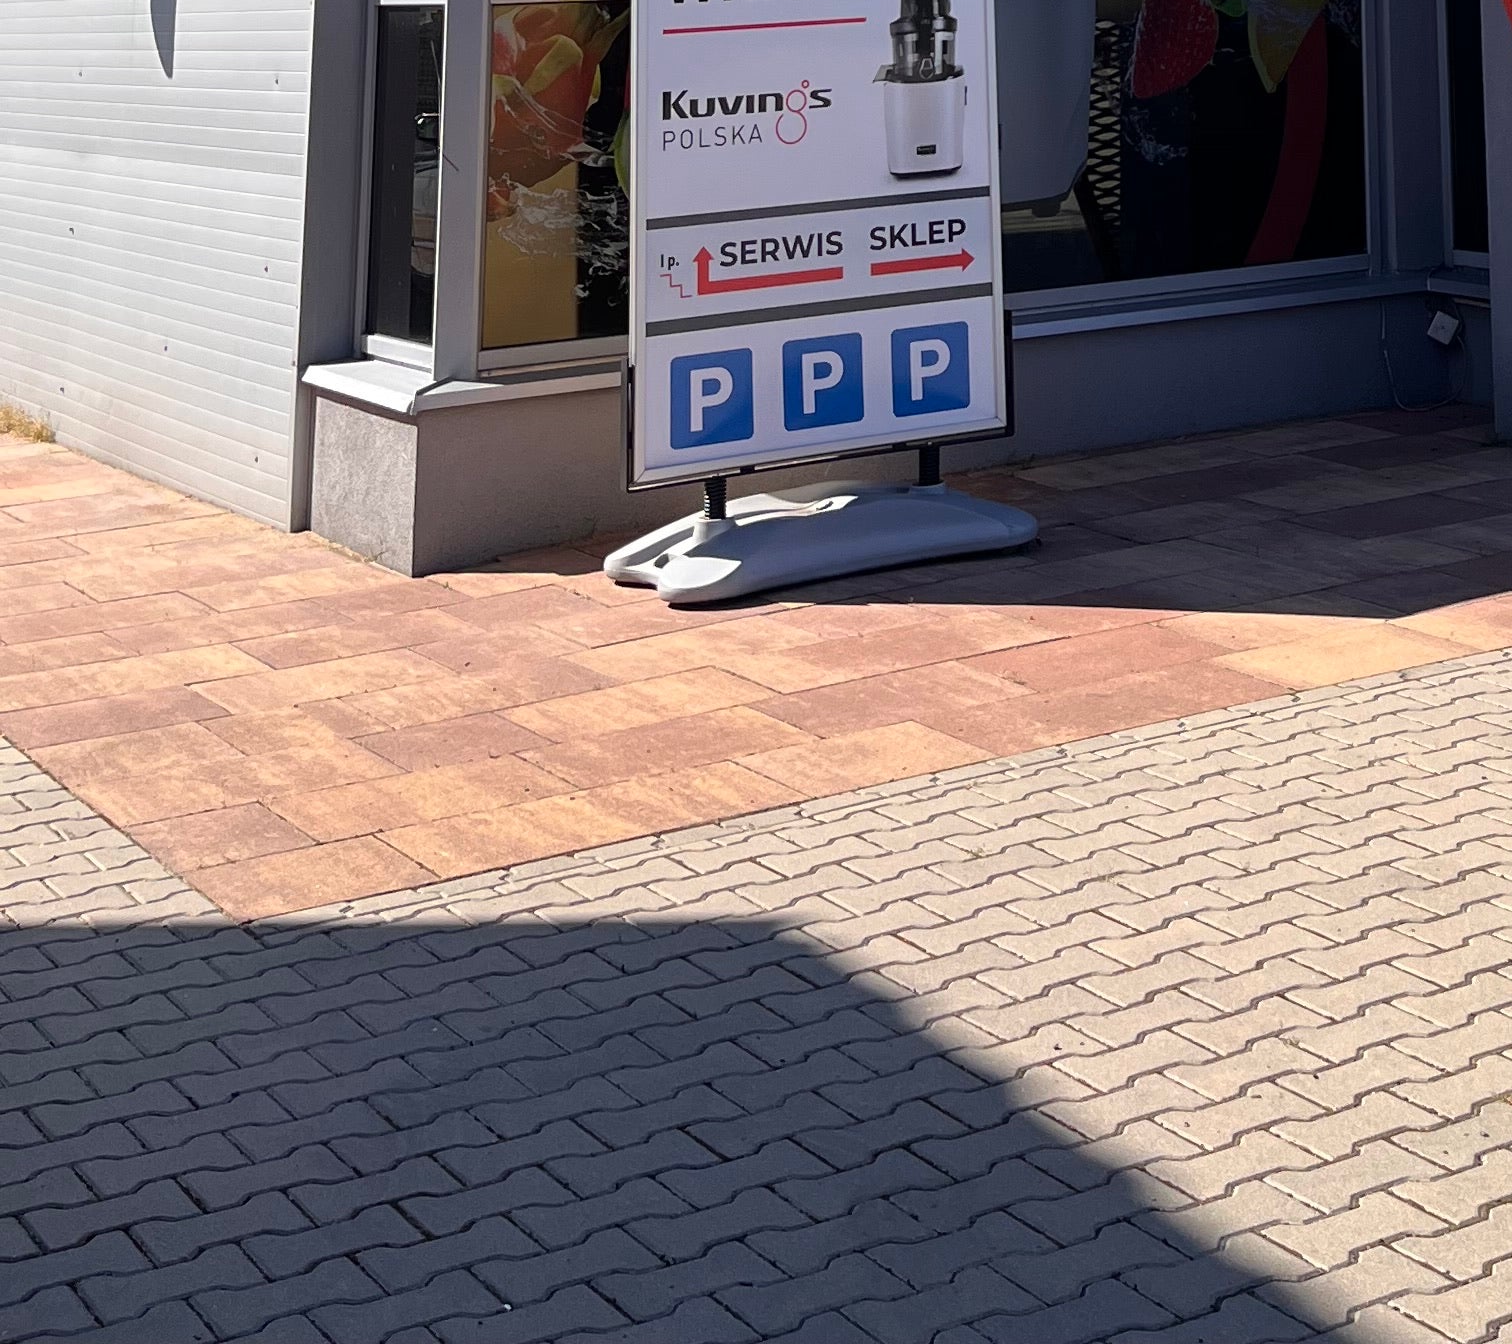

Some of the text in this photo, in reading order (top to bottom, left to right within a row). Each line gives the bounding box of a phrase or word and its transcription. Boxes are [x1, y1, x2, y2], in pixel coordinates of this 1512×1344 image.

[661, 79, 833, 145] Kuvings
[662, 123, 763, 152] POLSKA
[719, 218, 967, 268] SERWIS SKLEP
[688, 338, 951, 431] P P P
